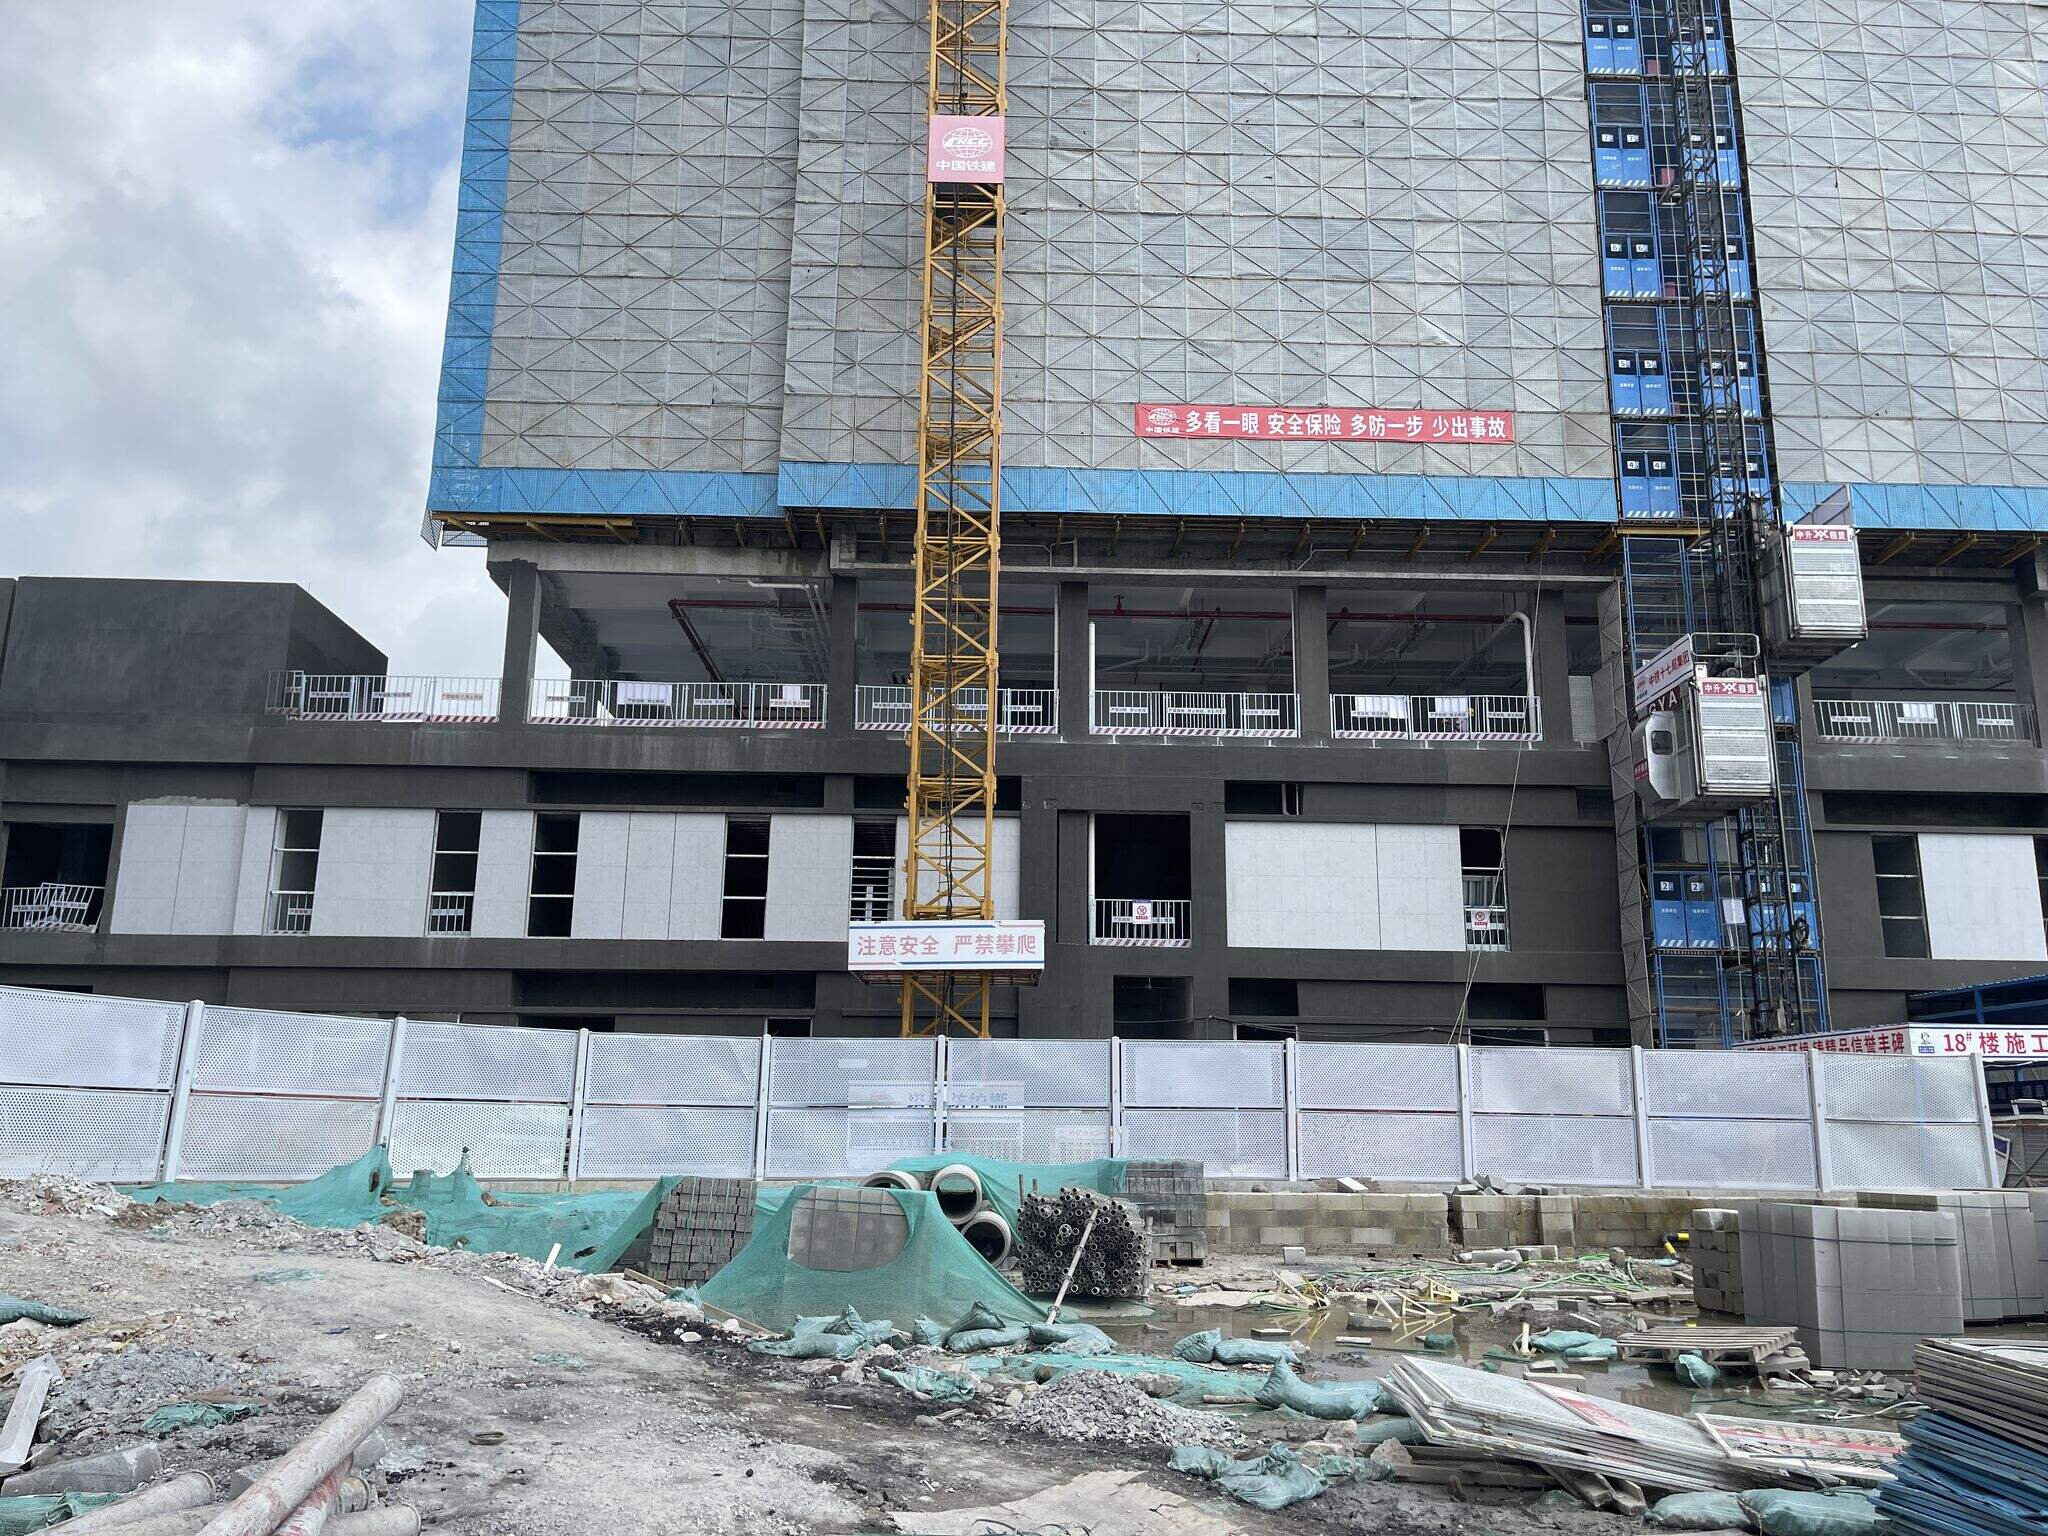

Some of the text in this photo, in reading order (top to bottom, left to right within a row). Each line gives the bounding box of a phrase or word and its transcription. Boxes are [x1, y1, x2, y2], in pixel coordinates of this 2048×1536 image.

[936, 159, 996, 172] 中国铁建
[1186, 411, 1506, 439] 多看一眼 安全保险 多防一步 少出事故
[857, 934, 1036, 956] 注意安全 严禁攀爬
